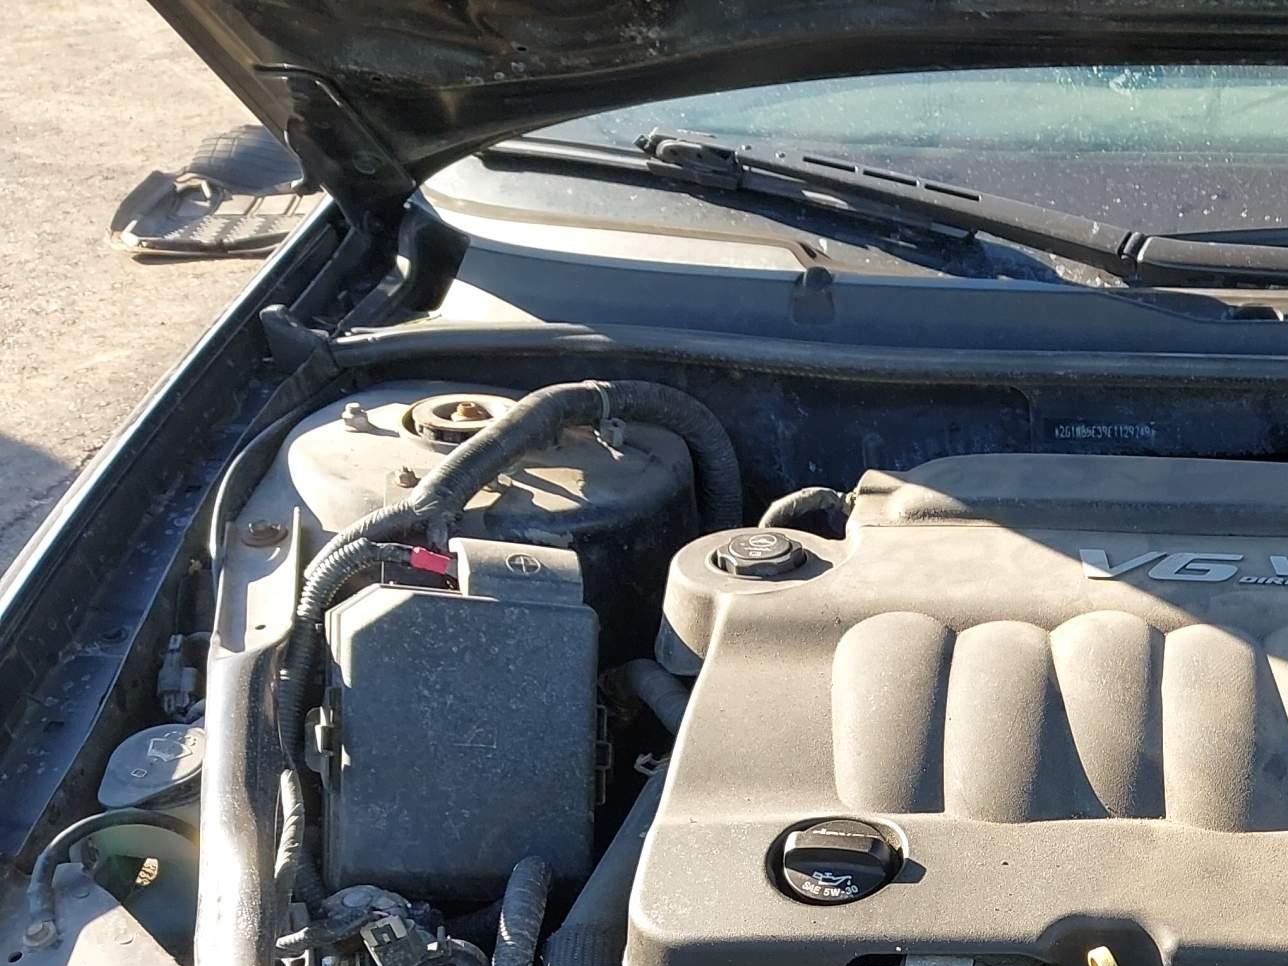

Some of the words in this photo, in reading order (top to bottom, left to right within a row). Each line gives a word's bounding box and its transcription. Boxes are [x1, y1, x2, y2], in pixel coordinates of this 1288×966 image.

[1079, 549, 1244, 582] V6
[802, 881, 821, 895] SAE
[823, 885, 858, 897] 5W-30
